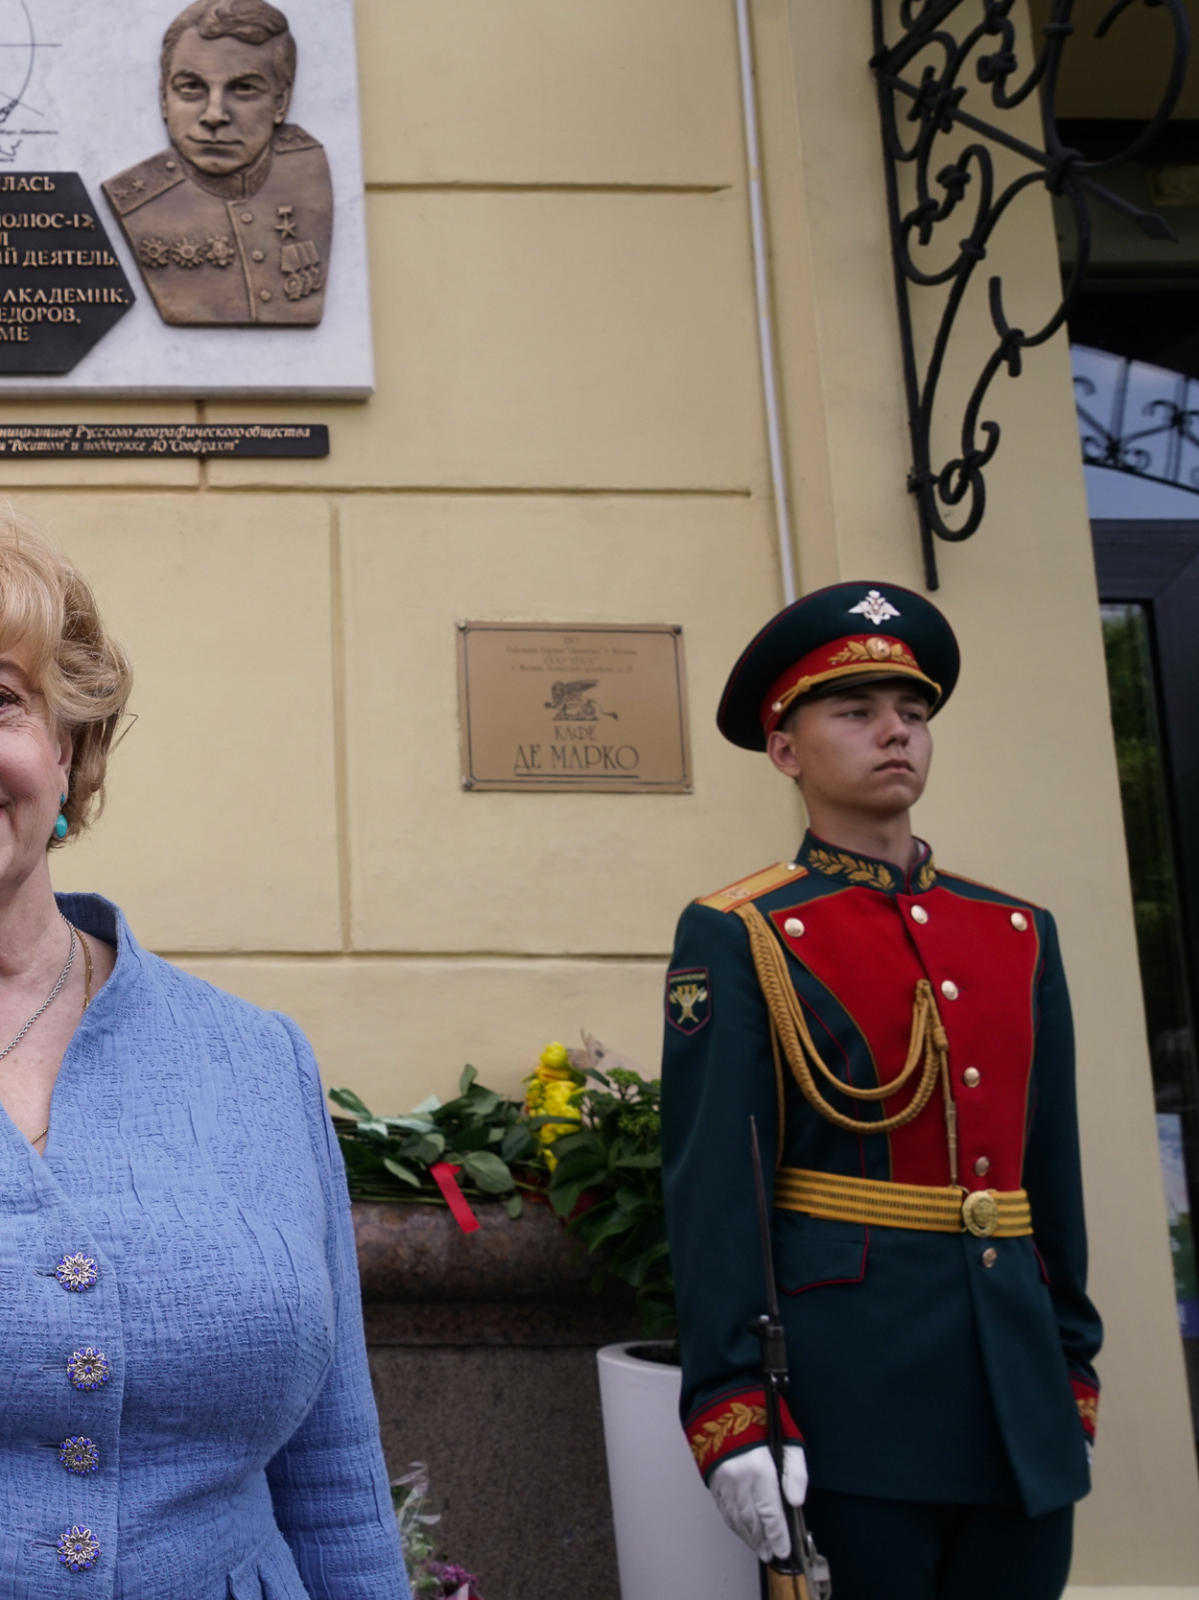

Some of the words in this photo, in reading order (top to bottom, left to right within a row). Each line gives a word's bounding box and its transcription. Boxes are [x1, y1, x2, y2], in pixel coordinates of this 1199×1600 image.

[23, 251, 120, 267] ДЕЯТЕЛЬ,
[76, 425, 133, 440] Русского
[134, 425, 245, 440] географического
[245, 426, 311, 440] общества
[70, 441, 80, 452] и
[83, 440, 146, 454] поддержке
[148, 439, 168, 453] АО
[554, 726, 597, 741] КАФЕ
[514, 744, 541, 775] ДЕ
[551, 745, 639, 770] МАРКО
